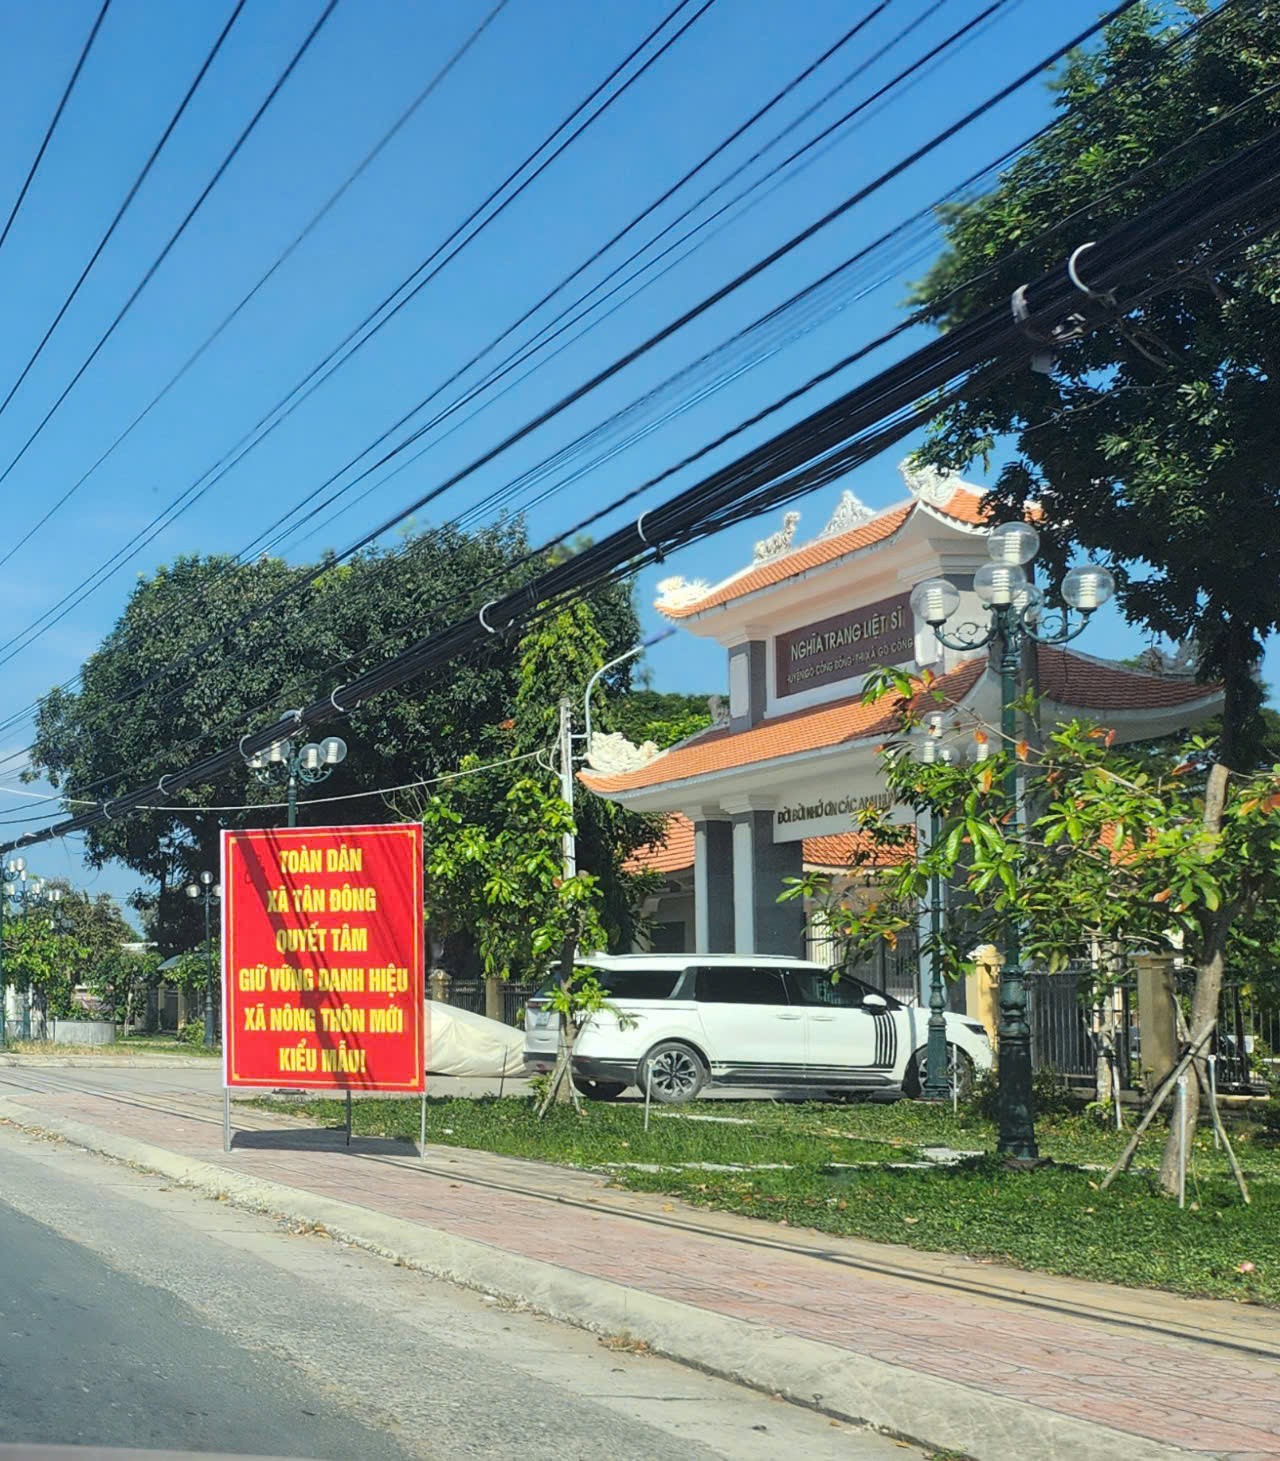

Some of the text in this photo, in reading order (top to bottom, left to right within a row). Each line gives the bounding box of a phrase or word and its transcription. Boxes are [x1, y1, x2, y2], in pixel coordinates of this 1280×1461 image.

[791, 605, 904, 662] NGHĨA TRANG LIỆT SĨ
[279, 844, 362, 874] TOÀN DÂN
[291, 884, 327, 914] TÂN
[328, 883, 376, 913] ĐÔNG
[275, 921, 368, 954] QUYẾT TÂM
[238, 963, 409, 998] GIỮ VỮNG DANH HIỆU
[244, 1003, 404, 1033] XÃ NÔNG THÔN MỚI
[278, 1039, 366, 1073] KIỂU MẪU!
